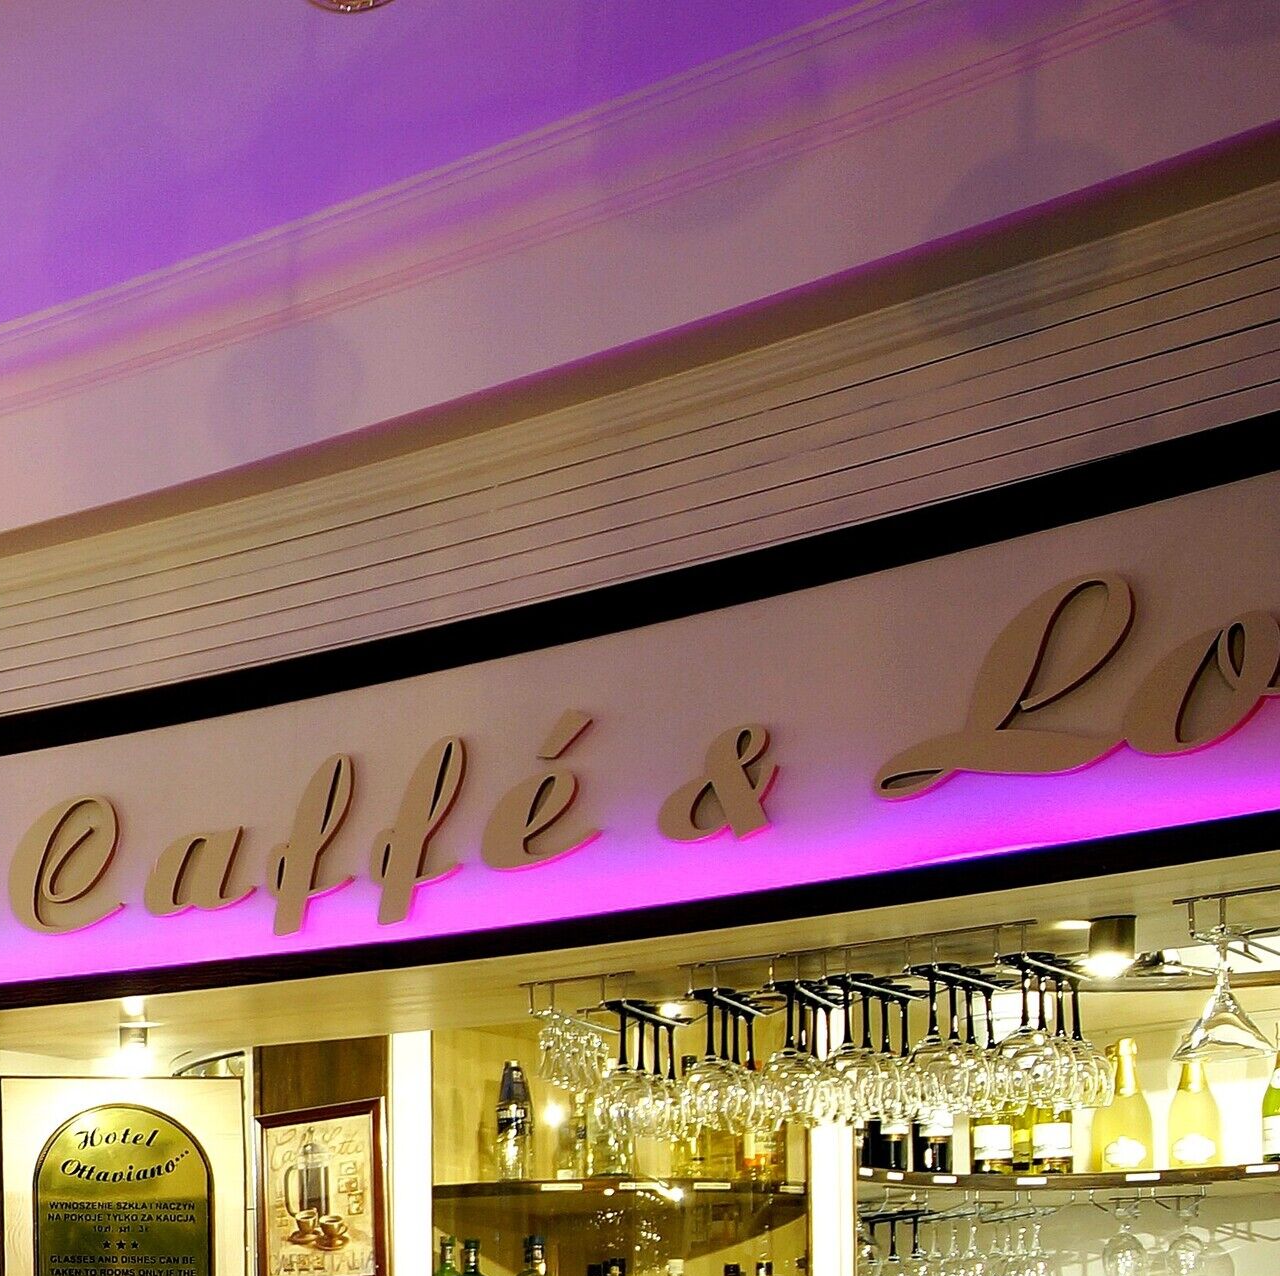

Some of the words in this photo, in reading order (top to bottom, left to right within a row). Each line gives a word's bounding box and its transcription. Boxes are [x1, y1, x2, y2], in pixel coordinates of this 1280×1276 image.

[7, 708, 604, 935] Caffé
[657, 724, 781, 844] &
[75, 1126, 160, 1150] Hotel
[61, 1157, 177, 1183] Ottaviano
[98, 1255, 118, 1263] AND
[121, 1255, 156, 1263] DISHES
[50, 1269, 84, 1276] TAKEN
[100, 1269, 135, 1276] ROOMS
[138, 1269, 163, 1276] ONLY
[178, 1269, 196, 1276] THE
